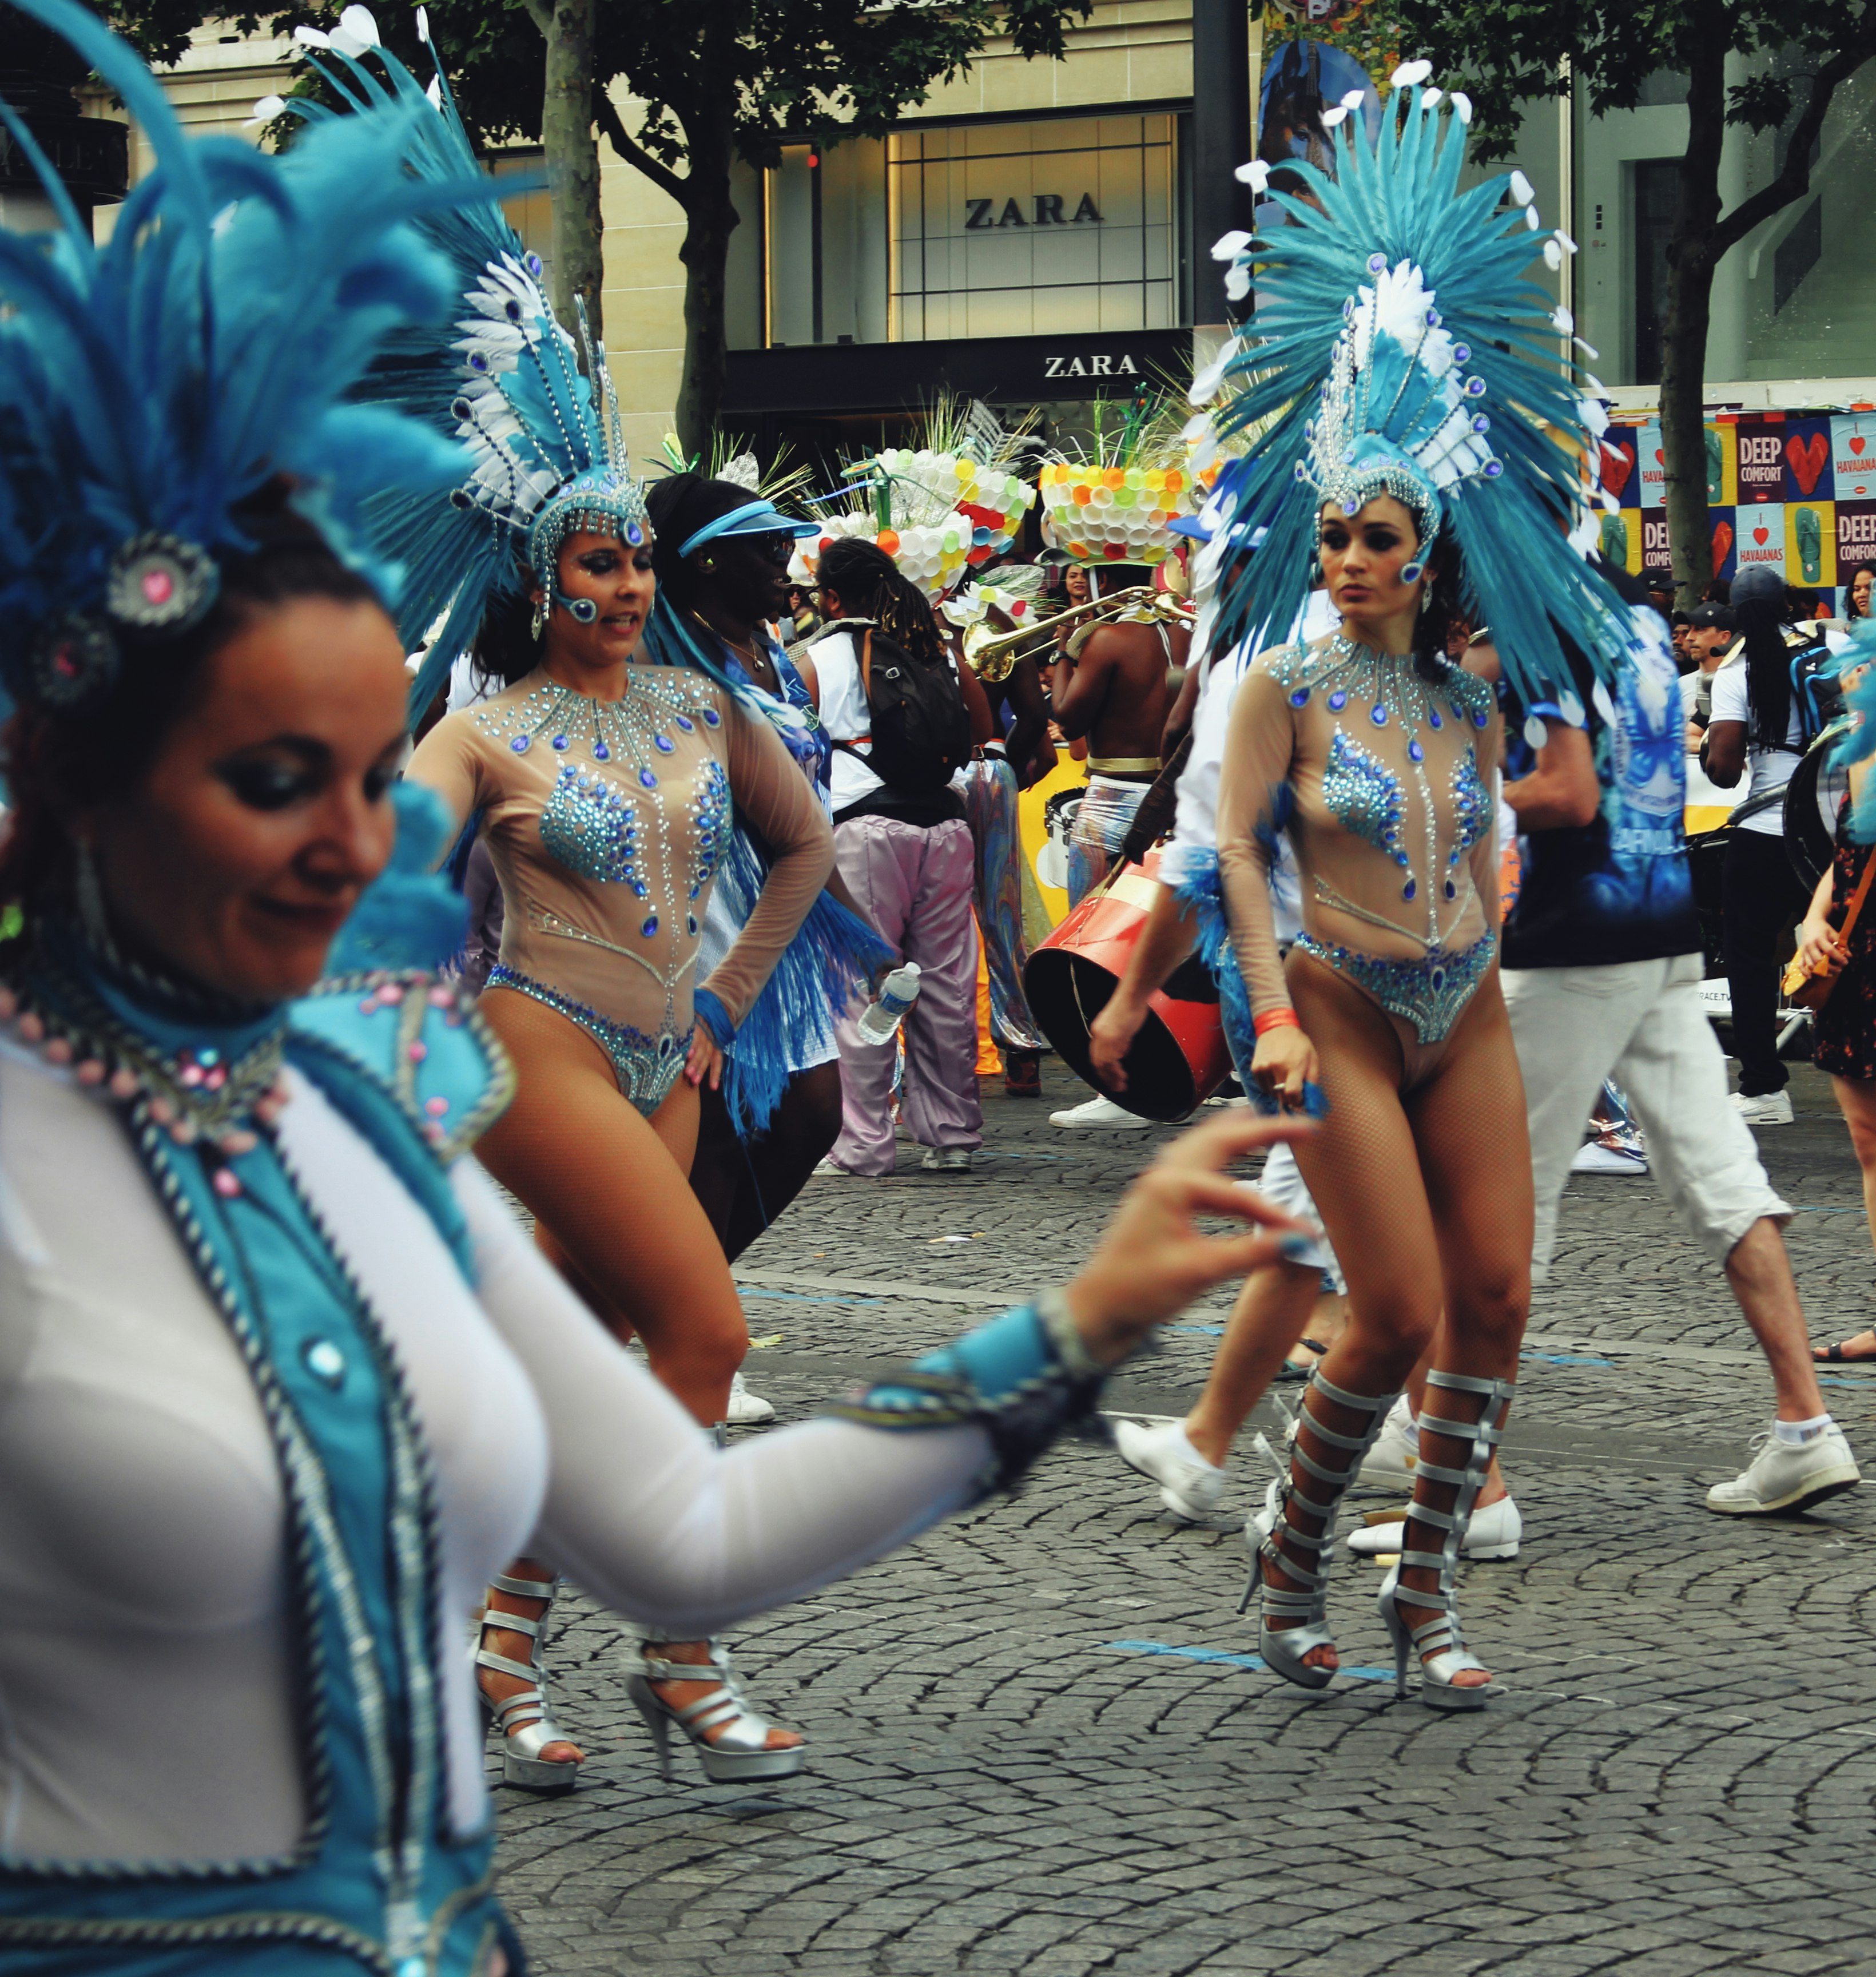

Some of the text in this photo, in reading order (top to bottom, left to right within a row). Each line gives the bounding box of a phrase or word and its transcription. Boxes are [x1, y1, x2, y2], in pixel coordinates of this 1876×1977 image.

[965, 192, 1104, 229] ZARA
[1045, 355, 1139, 377] ZARA
[1740, 437, 1782, 464] DEEP
[1741, 466, 1782, 482] COMFORT
[1740, 548, 1782, 562] HAVAIANAS
